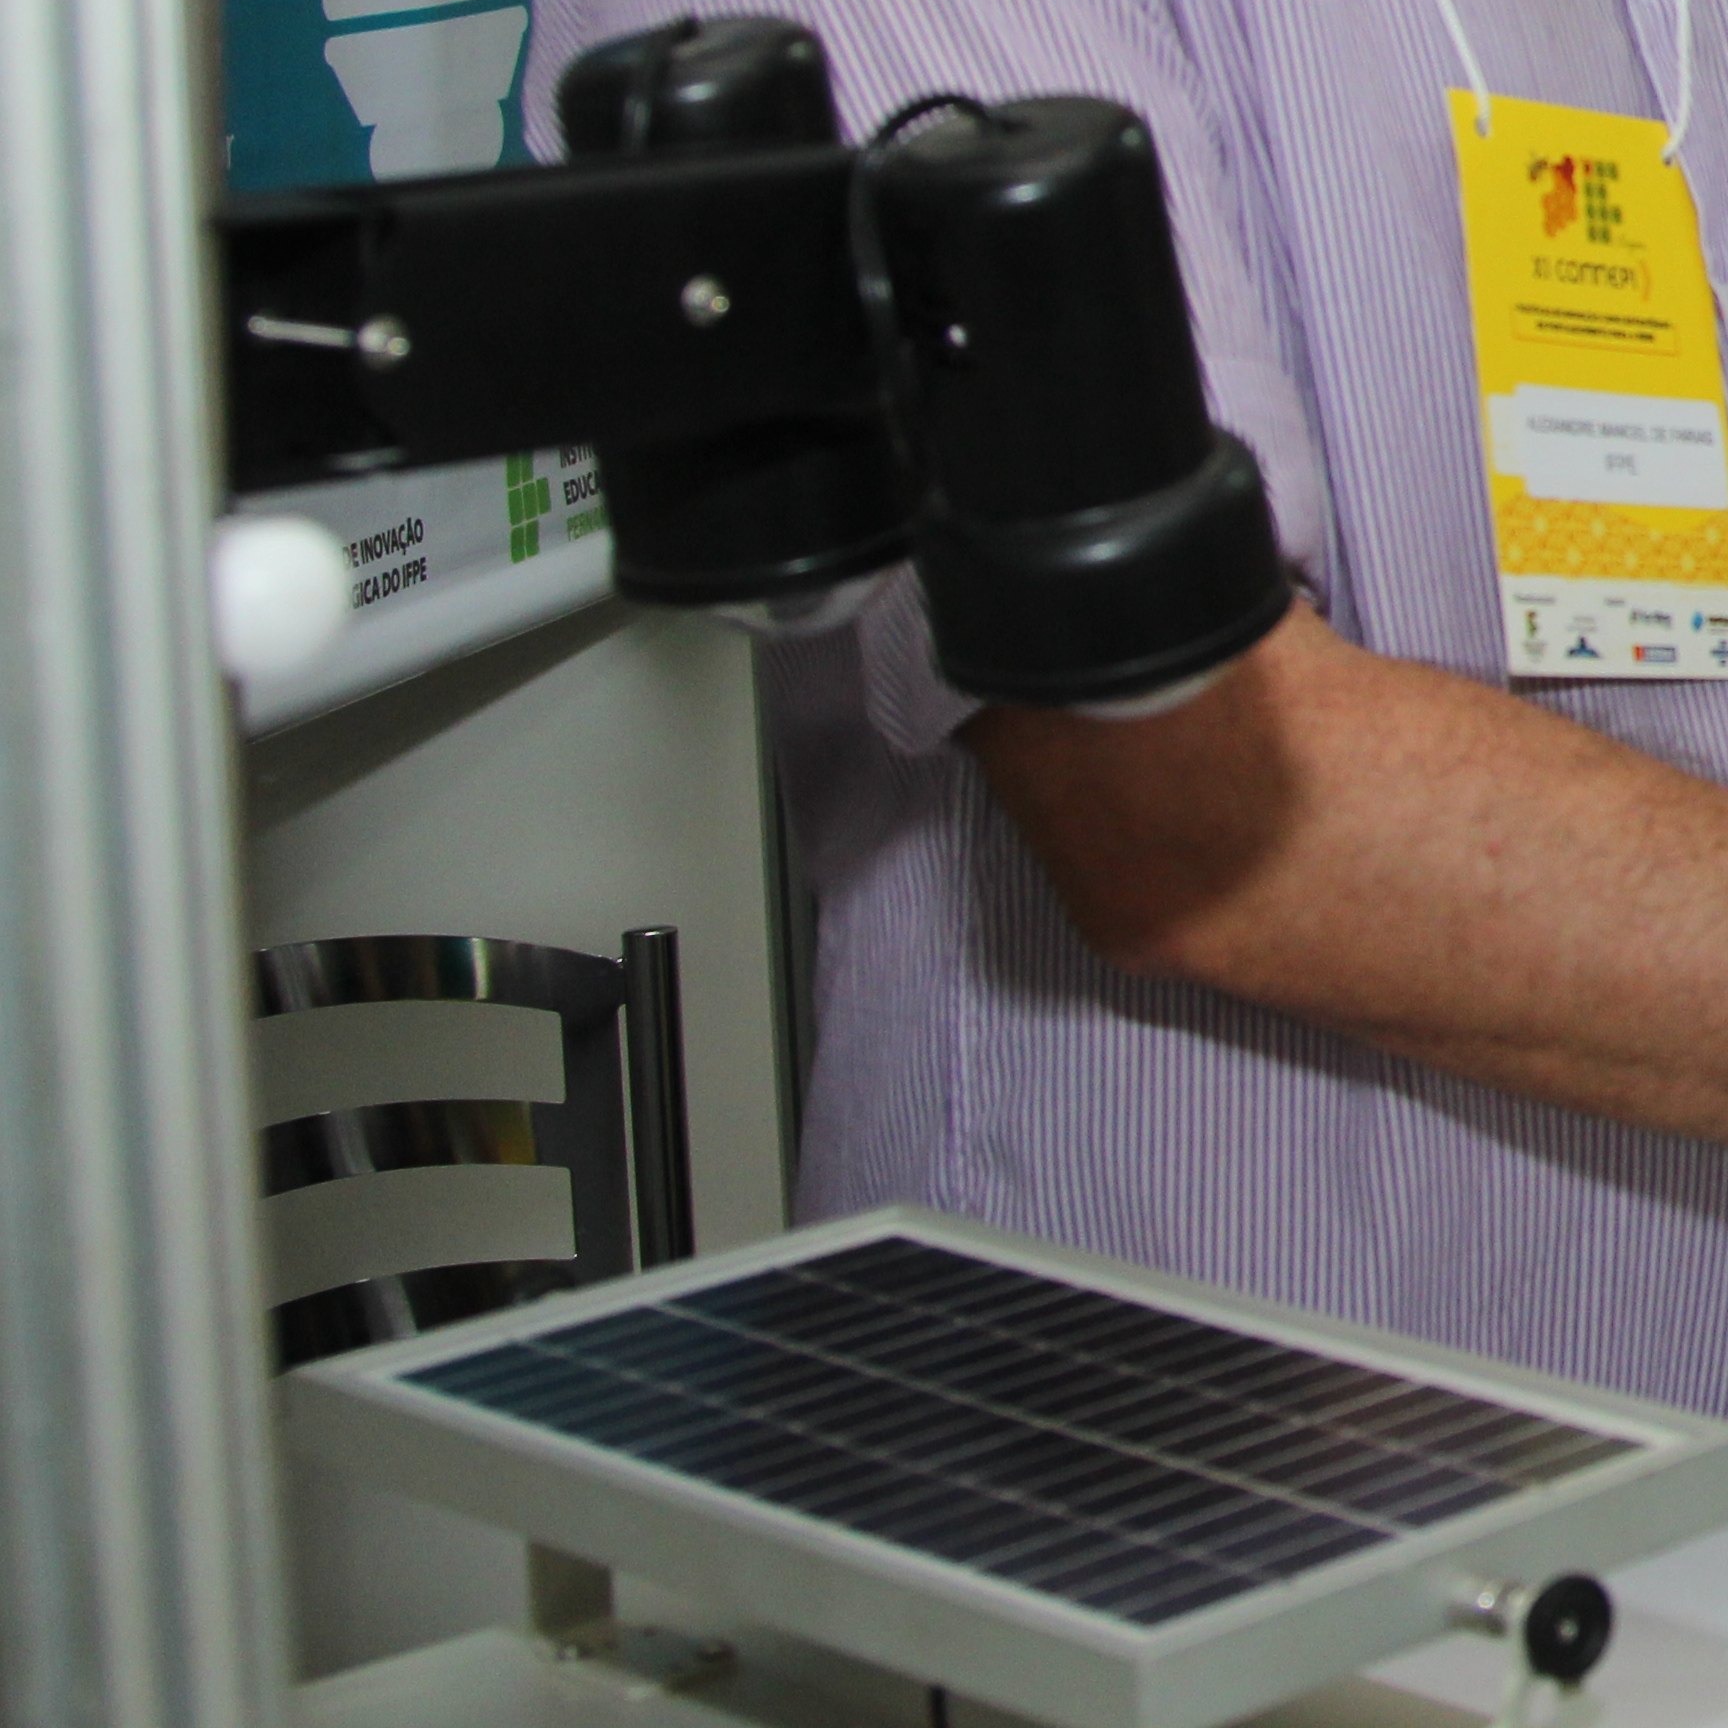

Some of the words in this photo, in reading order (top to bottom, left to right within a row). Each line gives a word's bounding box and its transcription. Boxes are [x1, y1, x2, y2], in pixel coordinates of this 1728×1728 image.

[360, 517, 424, 564] INOVAÇÃO
[353, 575, 381, 610] GICA
[382, 568, 401, 599] DO
[401, 557, 428, 590] IFPE
